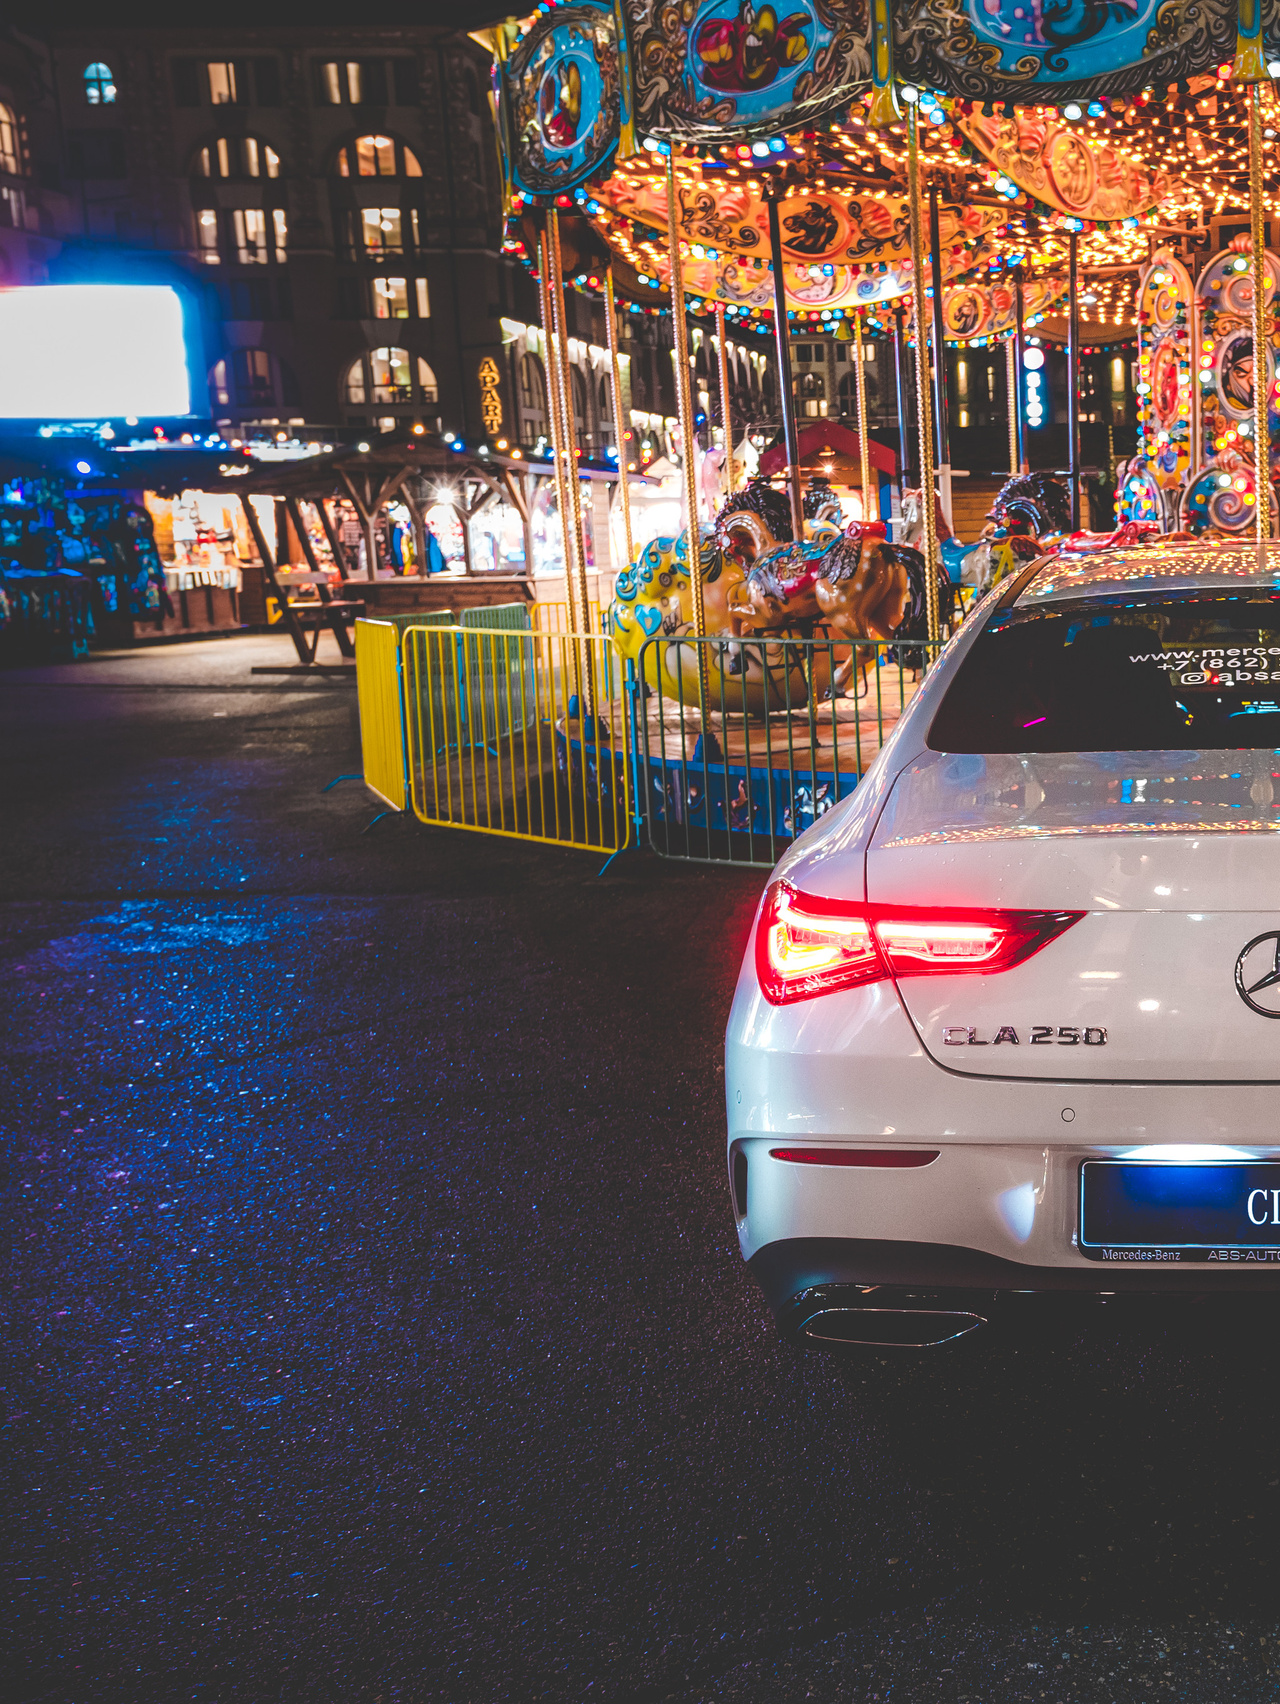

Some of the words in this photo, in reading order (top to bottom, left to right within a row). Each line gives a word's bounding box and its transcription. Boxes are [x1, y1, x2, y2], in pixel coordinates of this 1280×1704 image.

[1157, 660, 1190, 671] +7
[1200, 656, 1268, 671] (862)
[942, 1026, 1020, 1045] CLA
[1029, 1026, 1108, 1046] 250
[1102, 1249, 1181, 1261] Mercedes-Benz
